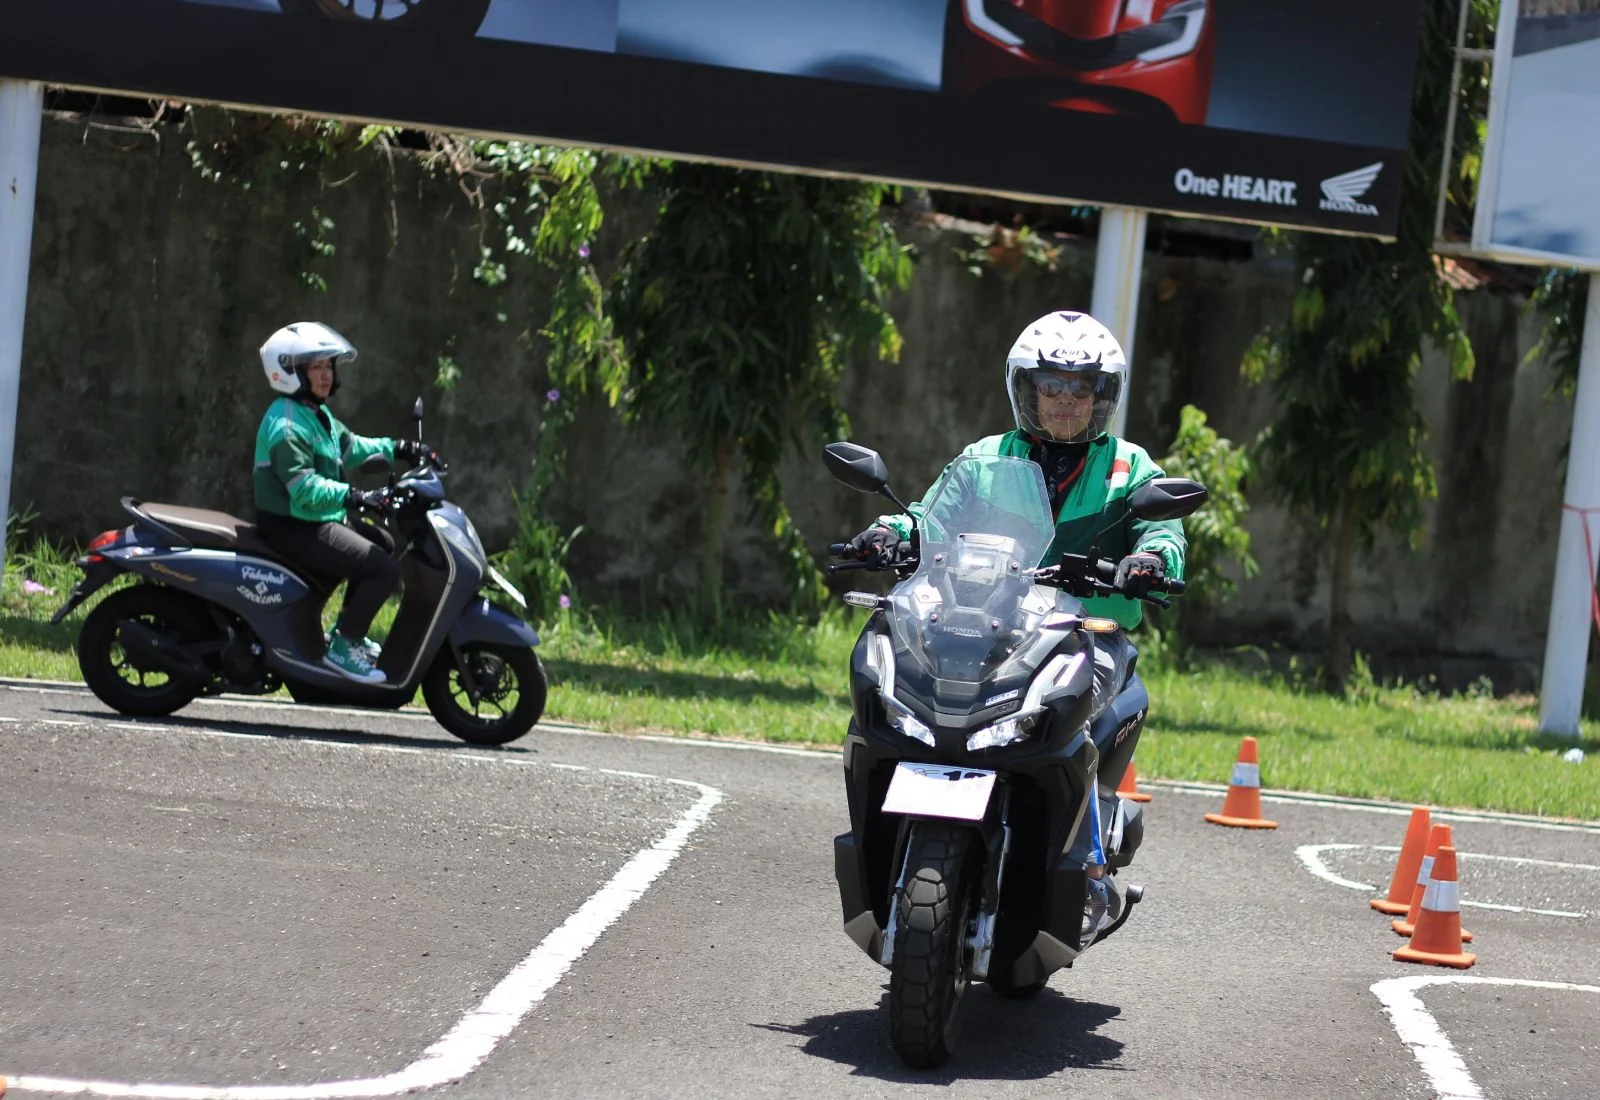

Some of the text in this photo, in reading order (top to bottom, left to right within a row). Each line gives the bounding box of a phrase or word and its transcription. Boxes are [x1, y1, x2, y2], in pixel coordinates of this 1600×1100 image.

[1174, 168, 1297, 205] One HEART.
[1319, 199, 1379, 216] HONDA
[943, 625, 982, 637] HONDA
